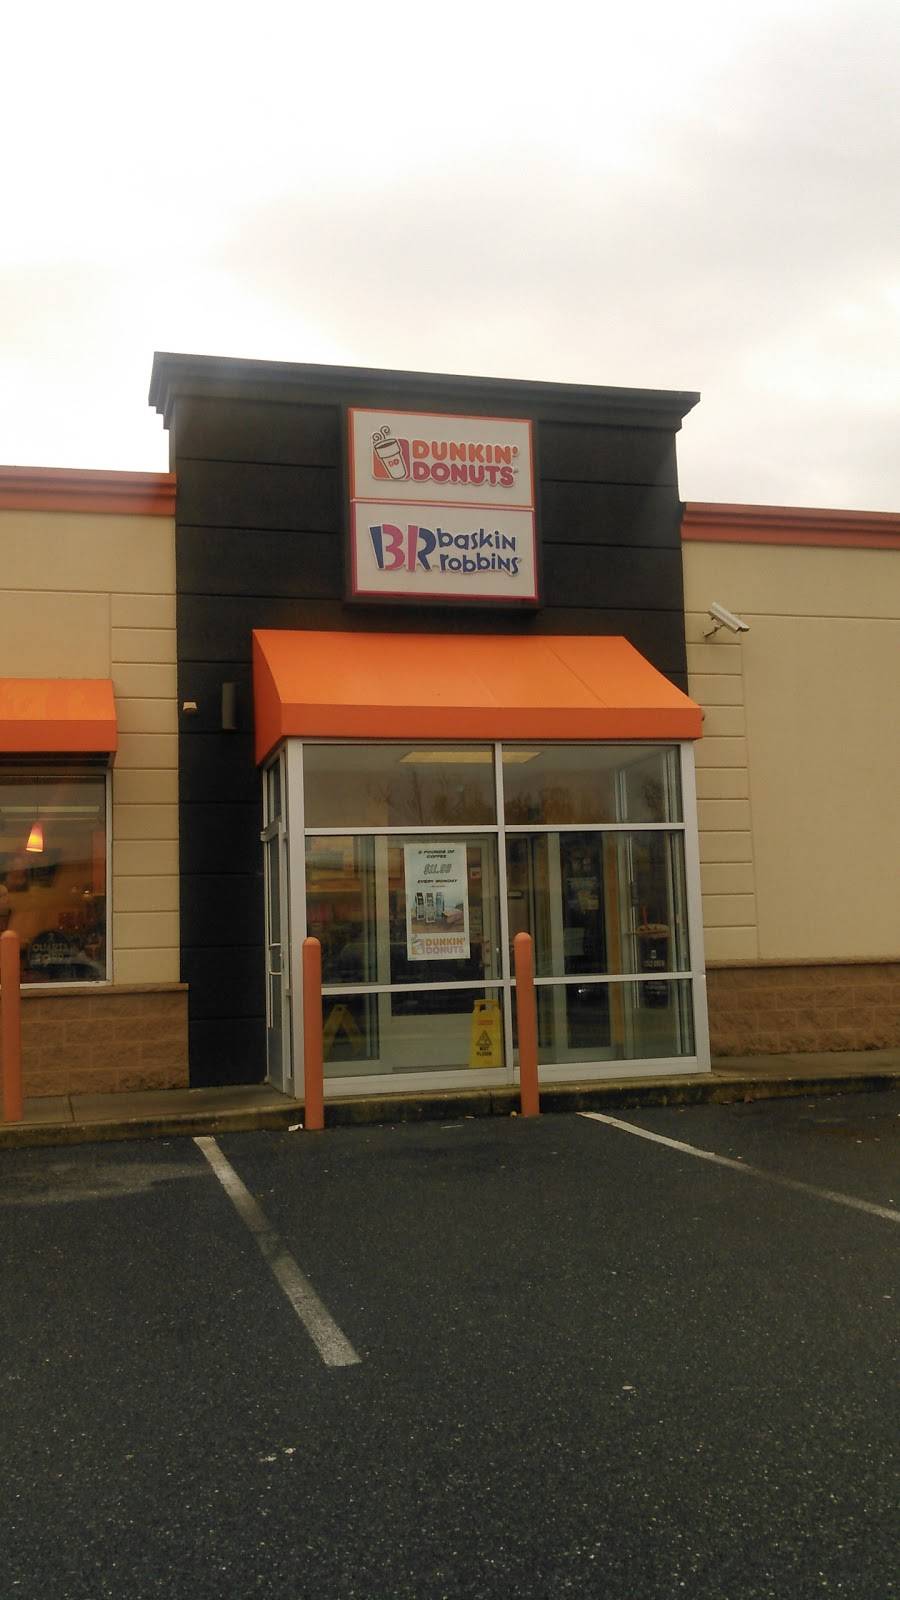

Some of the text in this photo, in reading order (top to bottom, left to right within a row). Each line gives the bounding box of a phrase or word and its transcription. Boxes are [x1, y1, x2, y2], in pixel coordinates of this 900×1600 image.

[411, 439, 519, 465] DUNKIN'
[411, 461, 514, 486] DONUTS
[436, 527, 516, 551] baskin
[439, 552, 519, 575] robbins
[425, 945, 464, 955] DONUTS
